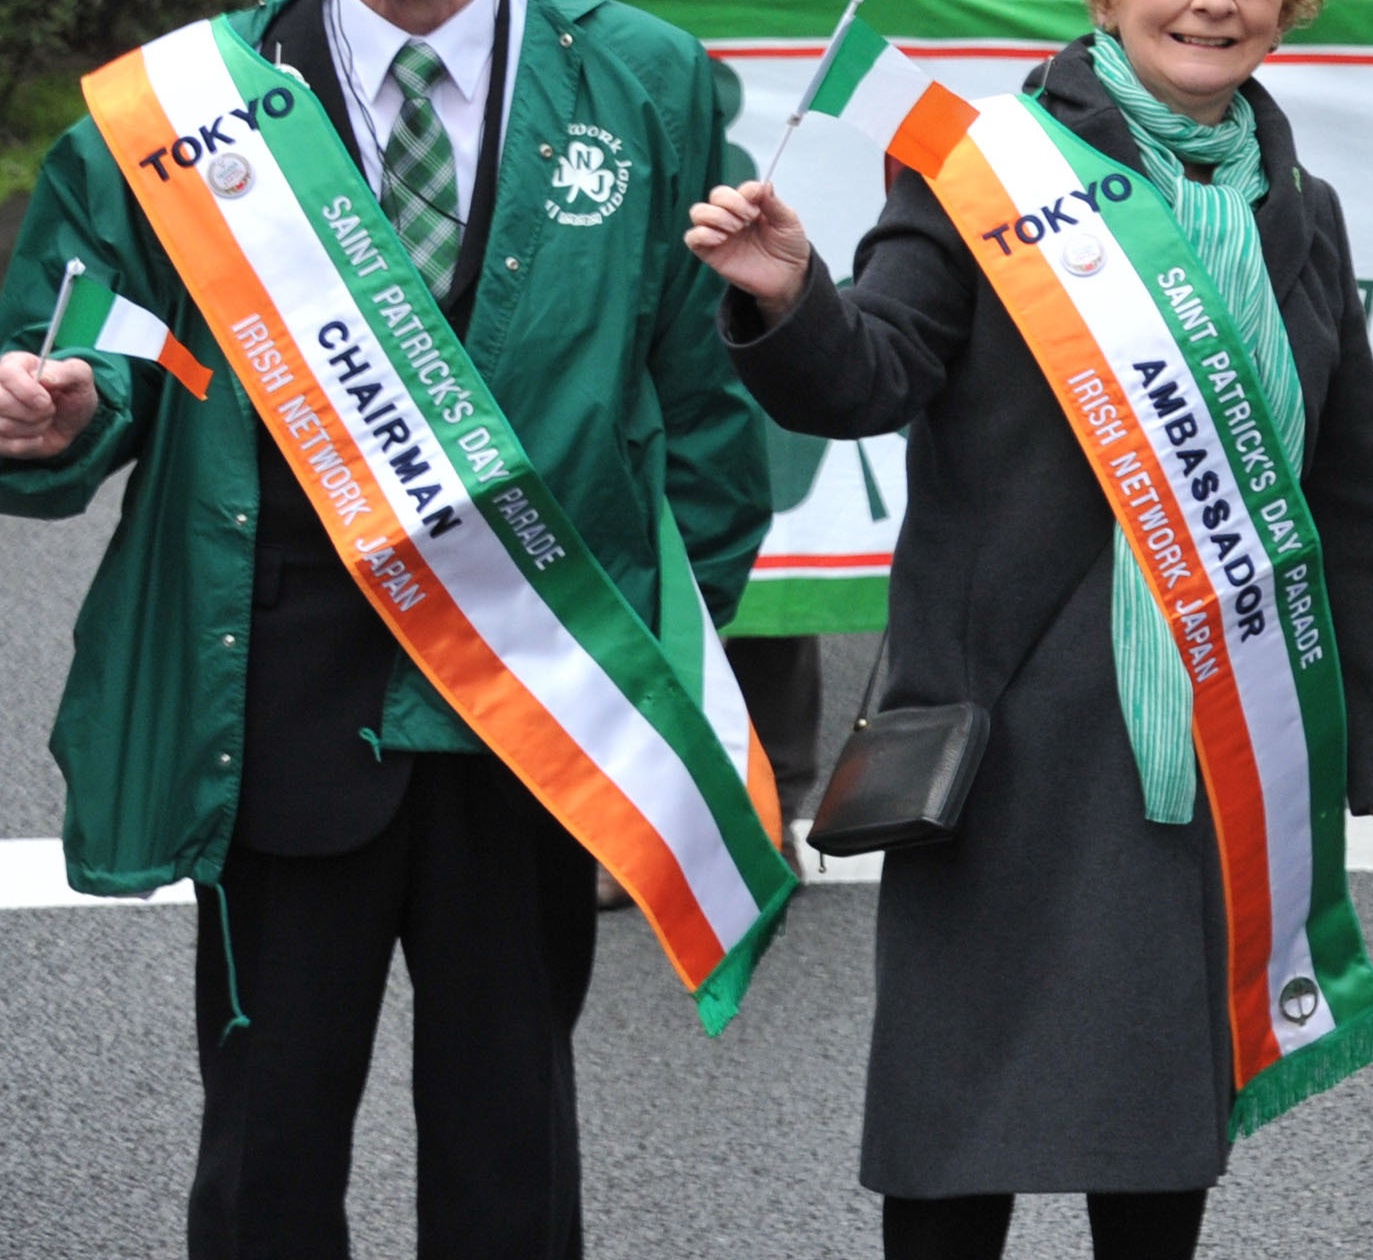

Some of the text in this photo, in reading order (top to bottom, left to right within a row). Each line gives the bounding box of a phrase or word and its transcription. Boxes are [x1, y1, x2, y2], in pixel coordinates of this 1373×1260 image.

[139, 86, 295, 183] TOKYO
[982, 172, 1133, 257] TOKYO
[230, 312, 429, 613] IRISH NETWORK JAPAN
[317, 320, 466, 541] CHAIRMAN
[322, 194, 566, 573] SAINT PATRICK'S DAY PARADE
[1067, 367, 1220, 684] IRISH NETWORK JAPAN
[1132, 359, 1267, 644] AMBASSADOR
[1156, 265, 1323, 670] SAINT PATRICK'S DAY PARADE
